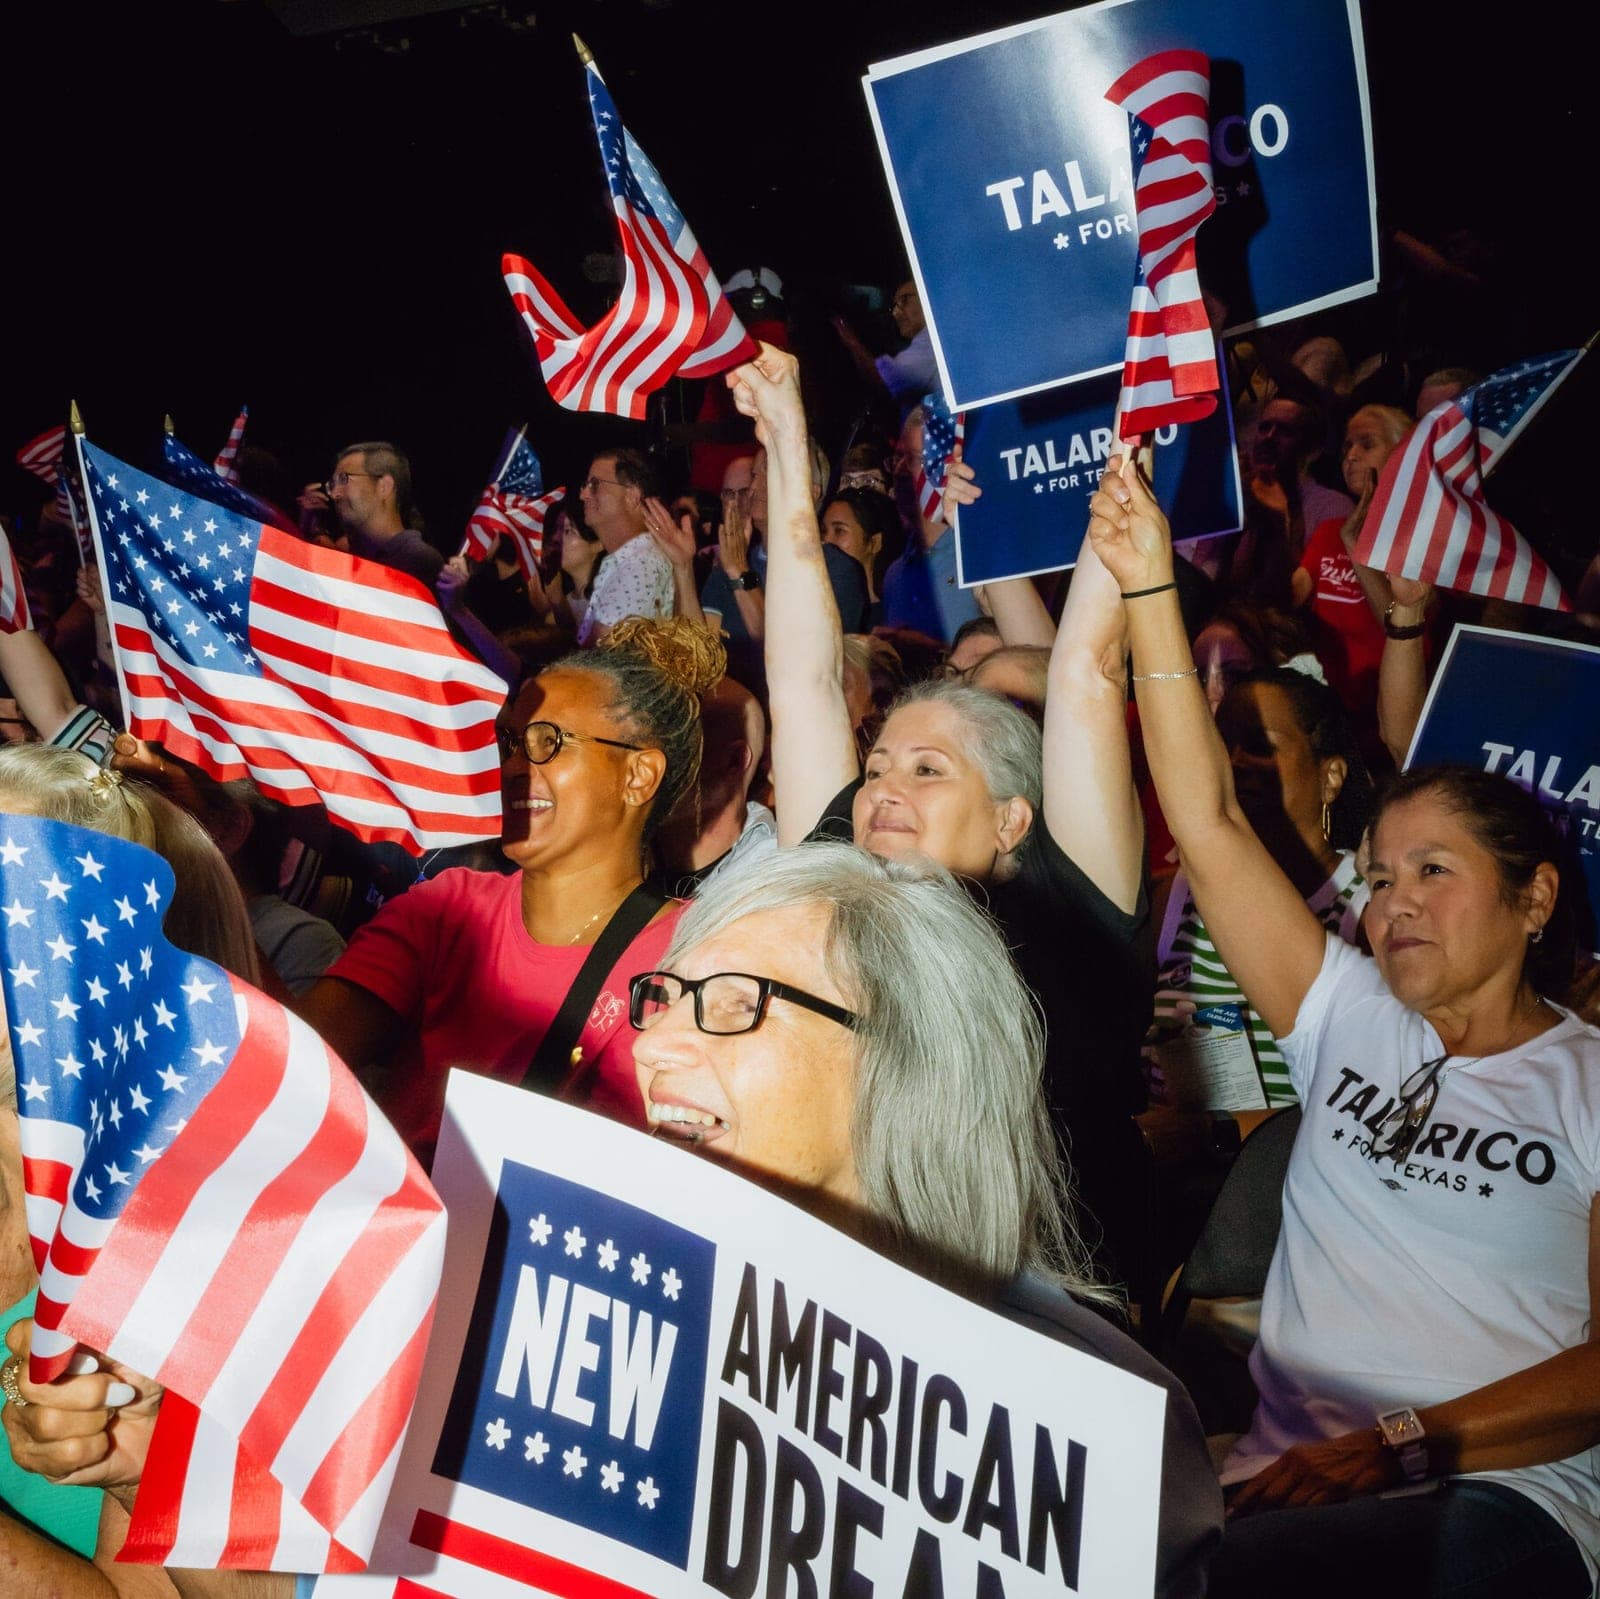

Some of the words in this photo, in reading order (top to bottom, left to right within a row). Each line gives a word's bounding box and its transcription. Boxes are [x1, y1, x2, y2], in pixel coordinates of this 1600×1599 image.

[986, 103, 1290, 231] TALACO
[1078, 213, 1132, 245] FOR
[1000, 423, 1178, 481] TALARO
[1049, 474, 1080, 492] FOR
[1481, 741, 1600, 809] TALA
[495, 1264, 677, 1452] NEW
[720, 1261, 1088, 1592] AMERICAN
[702, 1396, 1004, 1599] DRE
